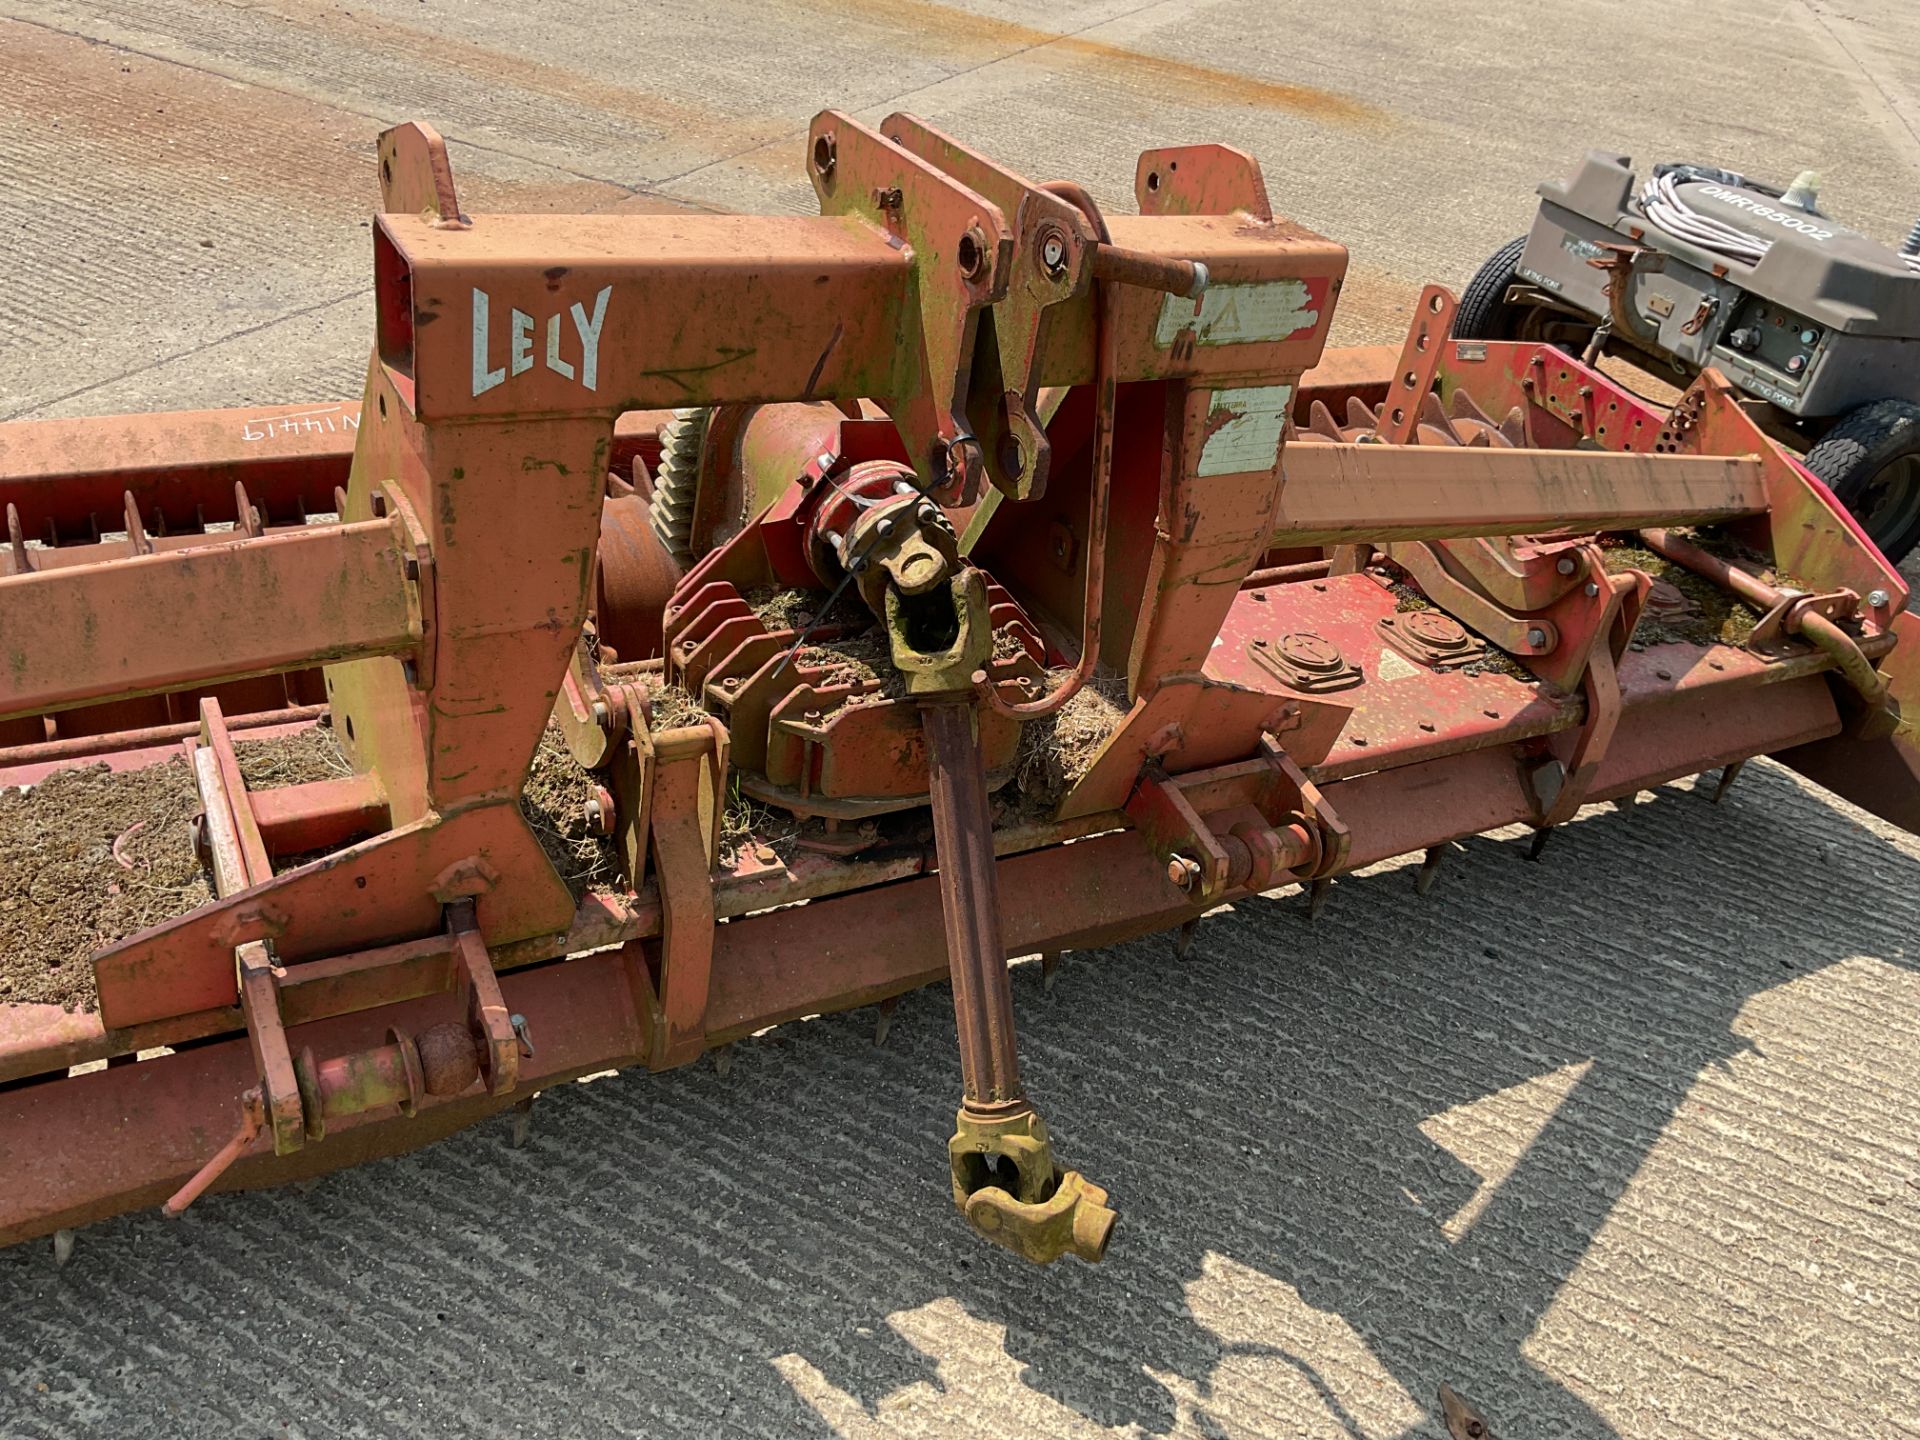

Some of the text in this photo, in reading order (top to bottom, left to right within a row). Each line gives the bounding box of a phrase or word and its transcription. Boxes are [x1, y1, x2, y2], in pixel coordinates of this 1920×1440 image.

[1698, 186, 1833, 241] DMR185002
[473, 285, 613, 397] LELY
[1772, 391, 1795, 407] POINT
